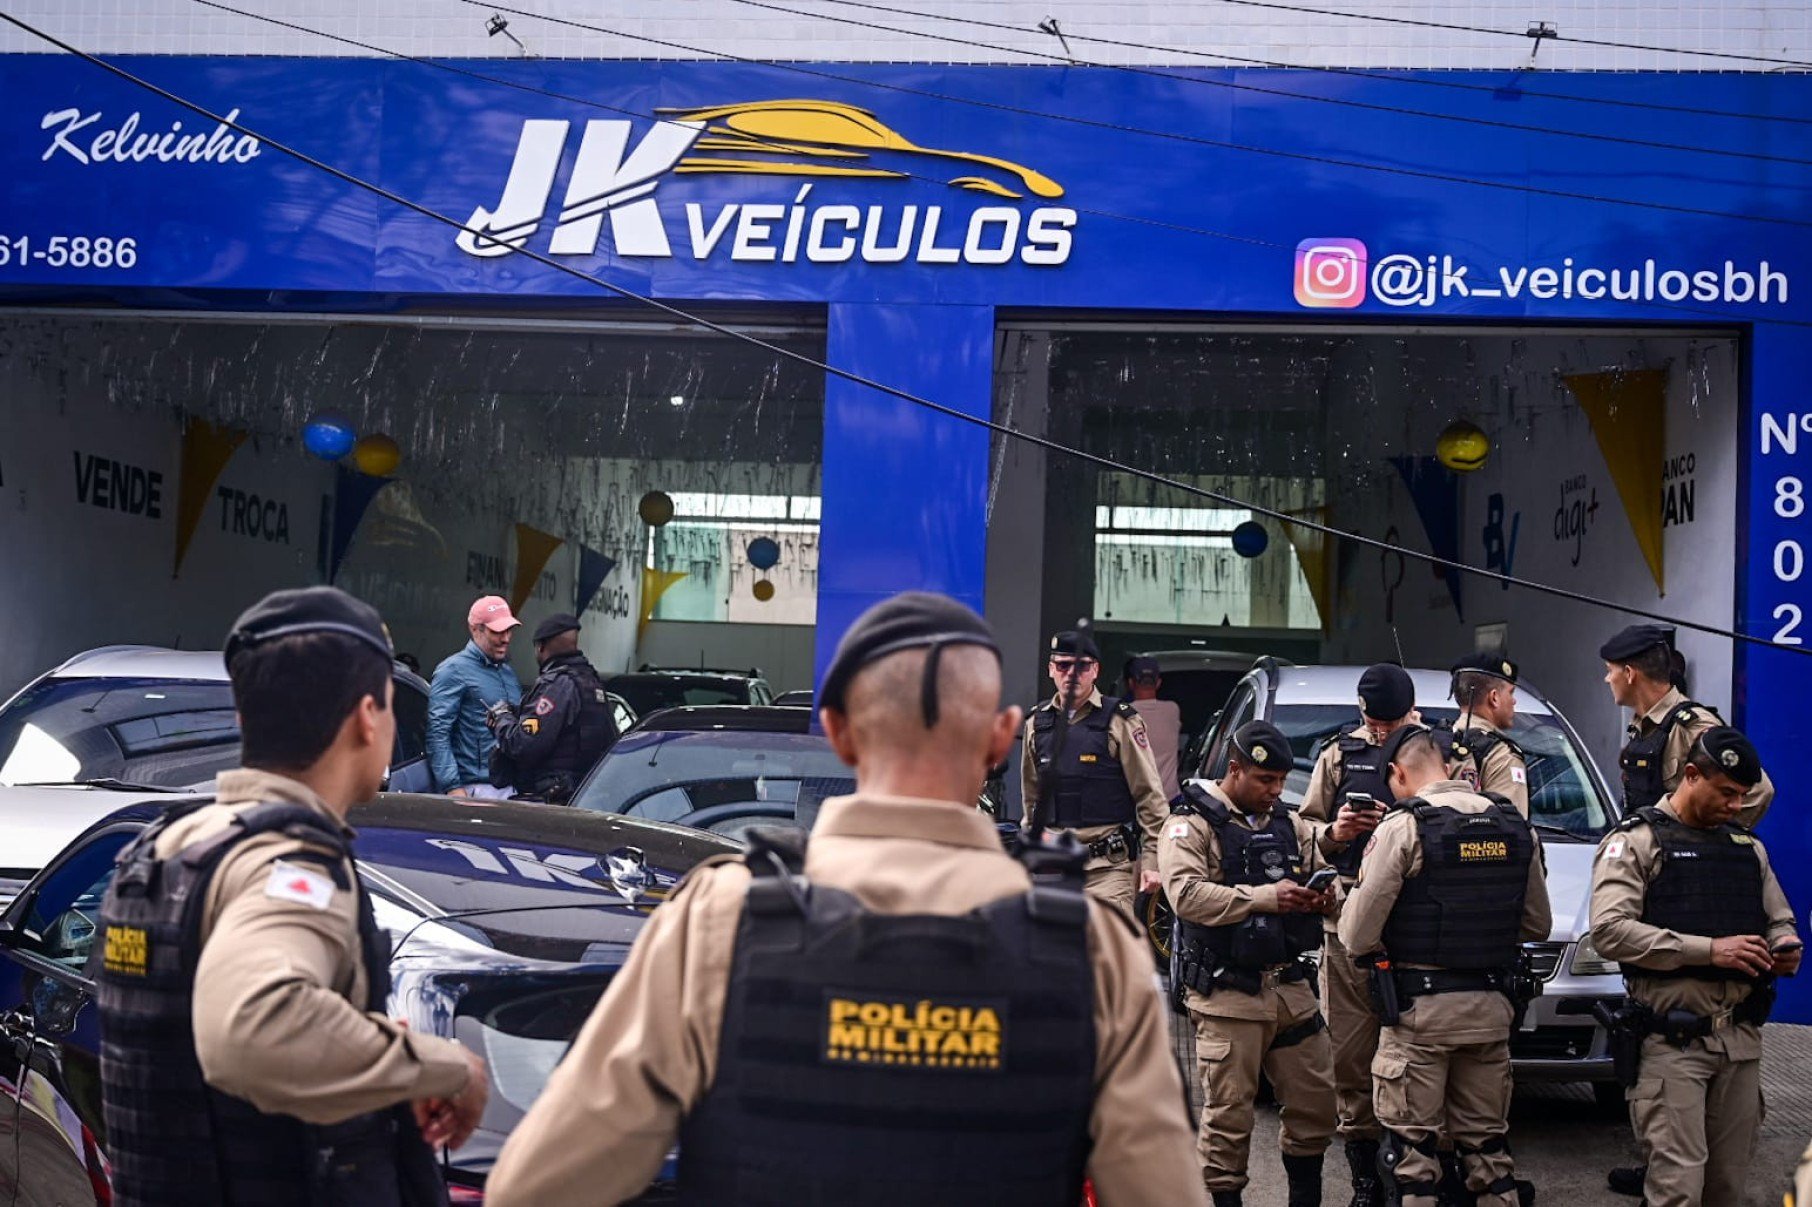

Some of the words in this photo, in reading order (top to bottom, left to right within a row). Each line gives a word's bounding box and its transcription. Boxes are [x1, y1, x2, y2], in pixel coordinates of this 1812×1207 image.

[41, 108, 261, 165] Kelvinho
[454, 119, 708, 258] JK
[685, 183, 1078, 265] VEÍCULOS
[1371, 254, 1788, 306] @jk_veiculosbh
[73, 450, 163, 519] VENDE
[1661, 453, 1696, 481] ANCO
[217, 486, 290, 544] TROCA
[1661, 479, 1695, 528] AN
[1459, 840, 1506, 851] POLÍCIA
[1460, 849, 1507, 857] MILITAR
[829, 999, 1000, 1032] POLÍCIA
[829, 1024, 1000, 1055] MILITAR
